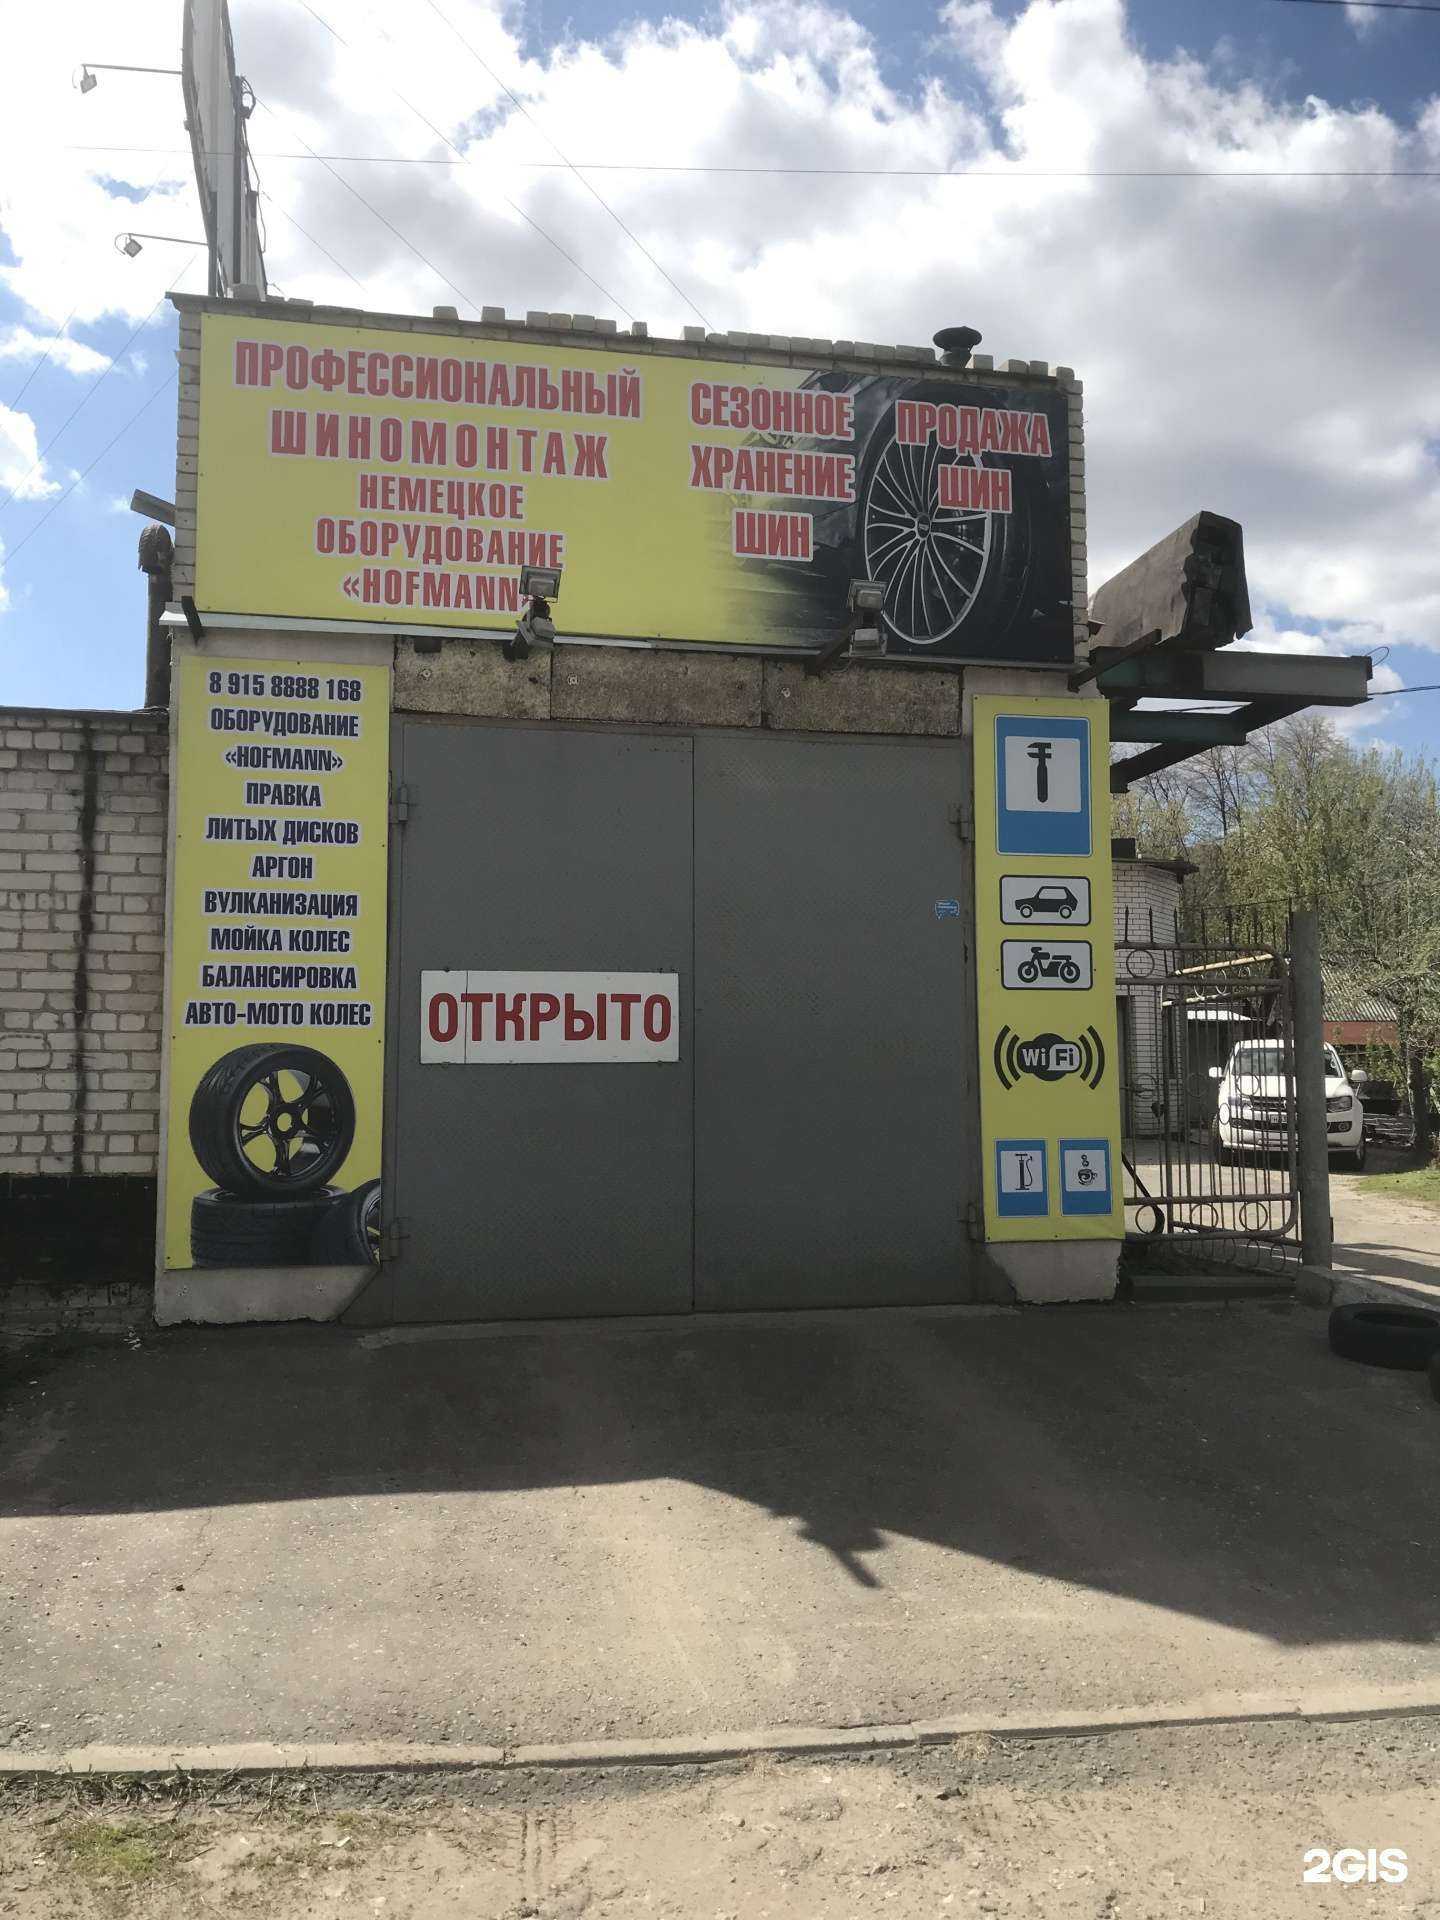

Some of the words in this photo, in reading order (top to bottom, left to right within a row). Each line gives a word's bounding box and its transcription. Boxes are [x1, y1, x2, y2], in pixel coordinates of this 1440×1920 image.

[236, 341, 641, 418] ПРОФЕССИОНАЛЬНЫЙ
[691, 383, 853, 437] СЕЗОННОЕ
[897, 401, 1051, 455] ПРОДАЖА
[272, 410, 608, 479] ШИНОМОНТАЖ
[691, 445, 854, 499] ХРАНЕНИЕ
[940, 465, 1011, 512] ШИН
[360, 474, 523, 521] НЕМЕЦКОЕ
[317, 518, 563, 568] ОБОРУДОВАНИЕ
[735, 511, 811, 558] ШИН
[209, 671, 222, 694] 8
[228, 672, 265, 696] 915
[271, 675, 319, 699] 8888
[326, 679, 361, 701] 168
[211, 708, 359, 737] ОБОРУДОВАНИЕ
[225, 746, 343, 771] «HOFMANN»
[246, 782, 321, 807] ПРАВКА
[206, 818, 277, 842] ЛИТЫХ
[282, 820, 359, 845] ДИСКОВ
[252, 856, 313, 878] АРГОН
[205, 891, 358, 918] ВУЛКАНИЗАЦИЯ
[211, 925, 282, 951] МОЙКА
[289, 929, 350, 952] КОЛЕС
[202, 965, 357, 989] БАЛАНСИРОВКА
[185, 1002, 303, 1025] АВТО-МОТО
[310, 1003, 371, 1026] КОЛЕС
[428, 992, 672, 1042] ОТКРЫТО
